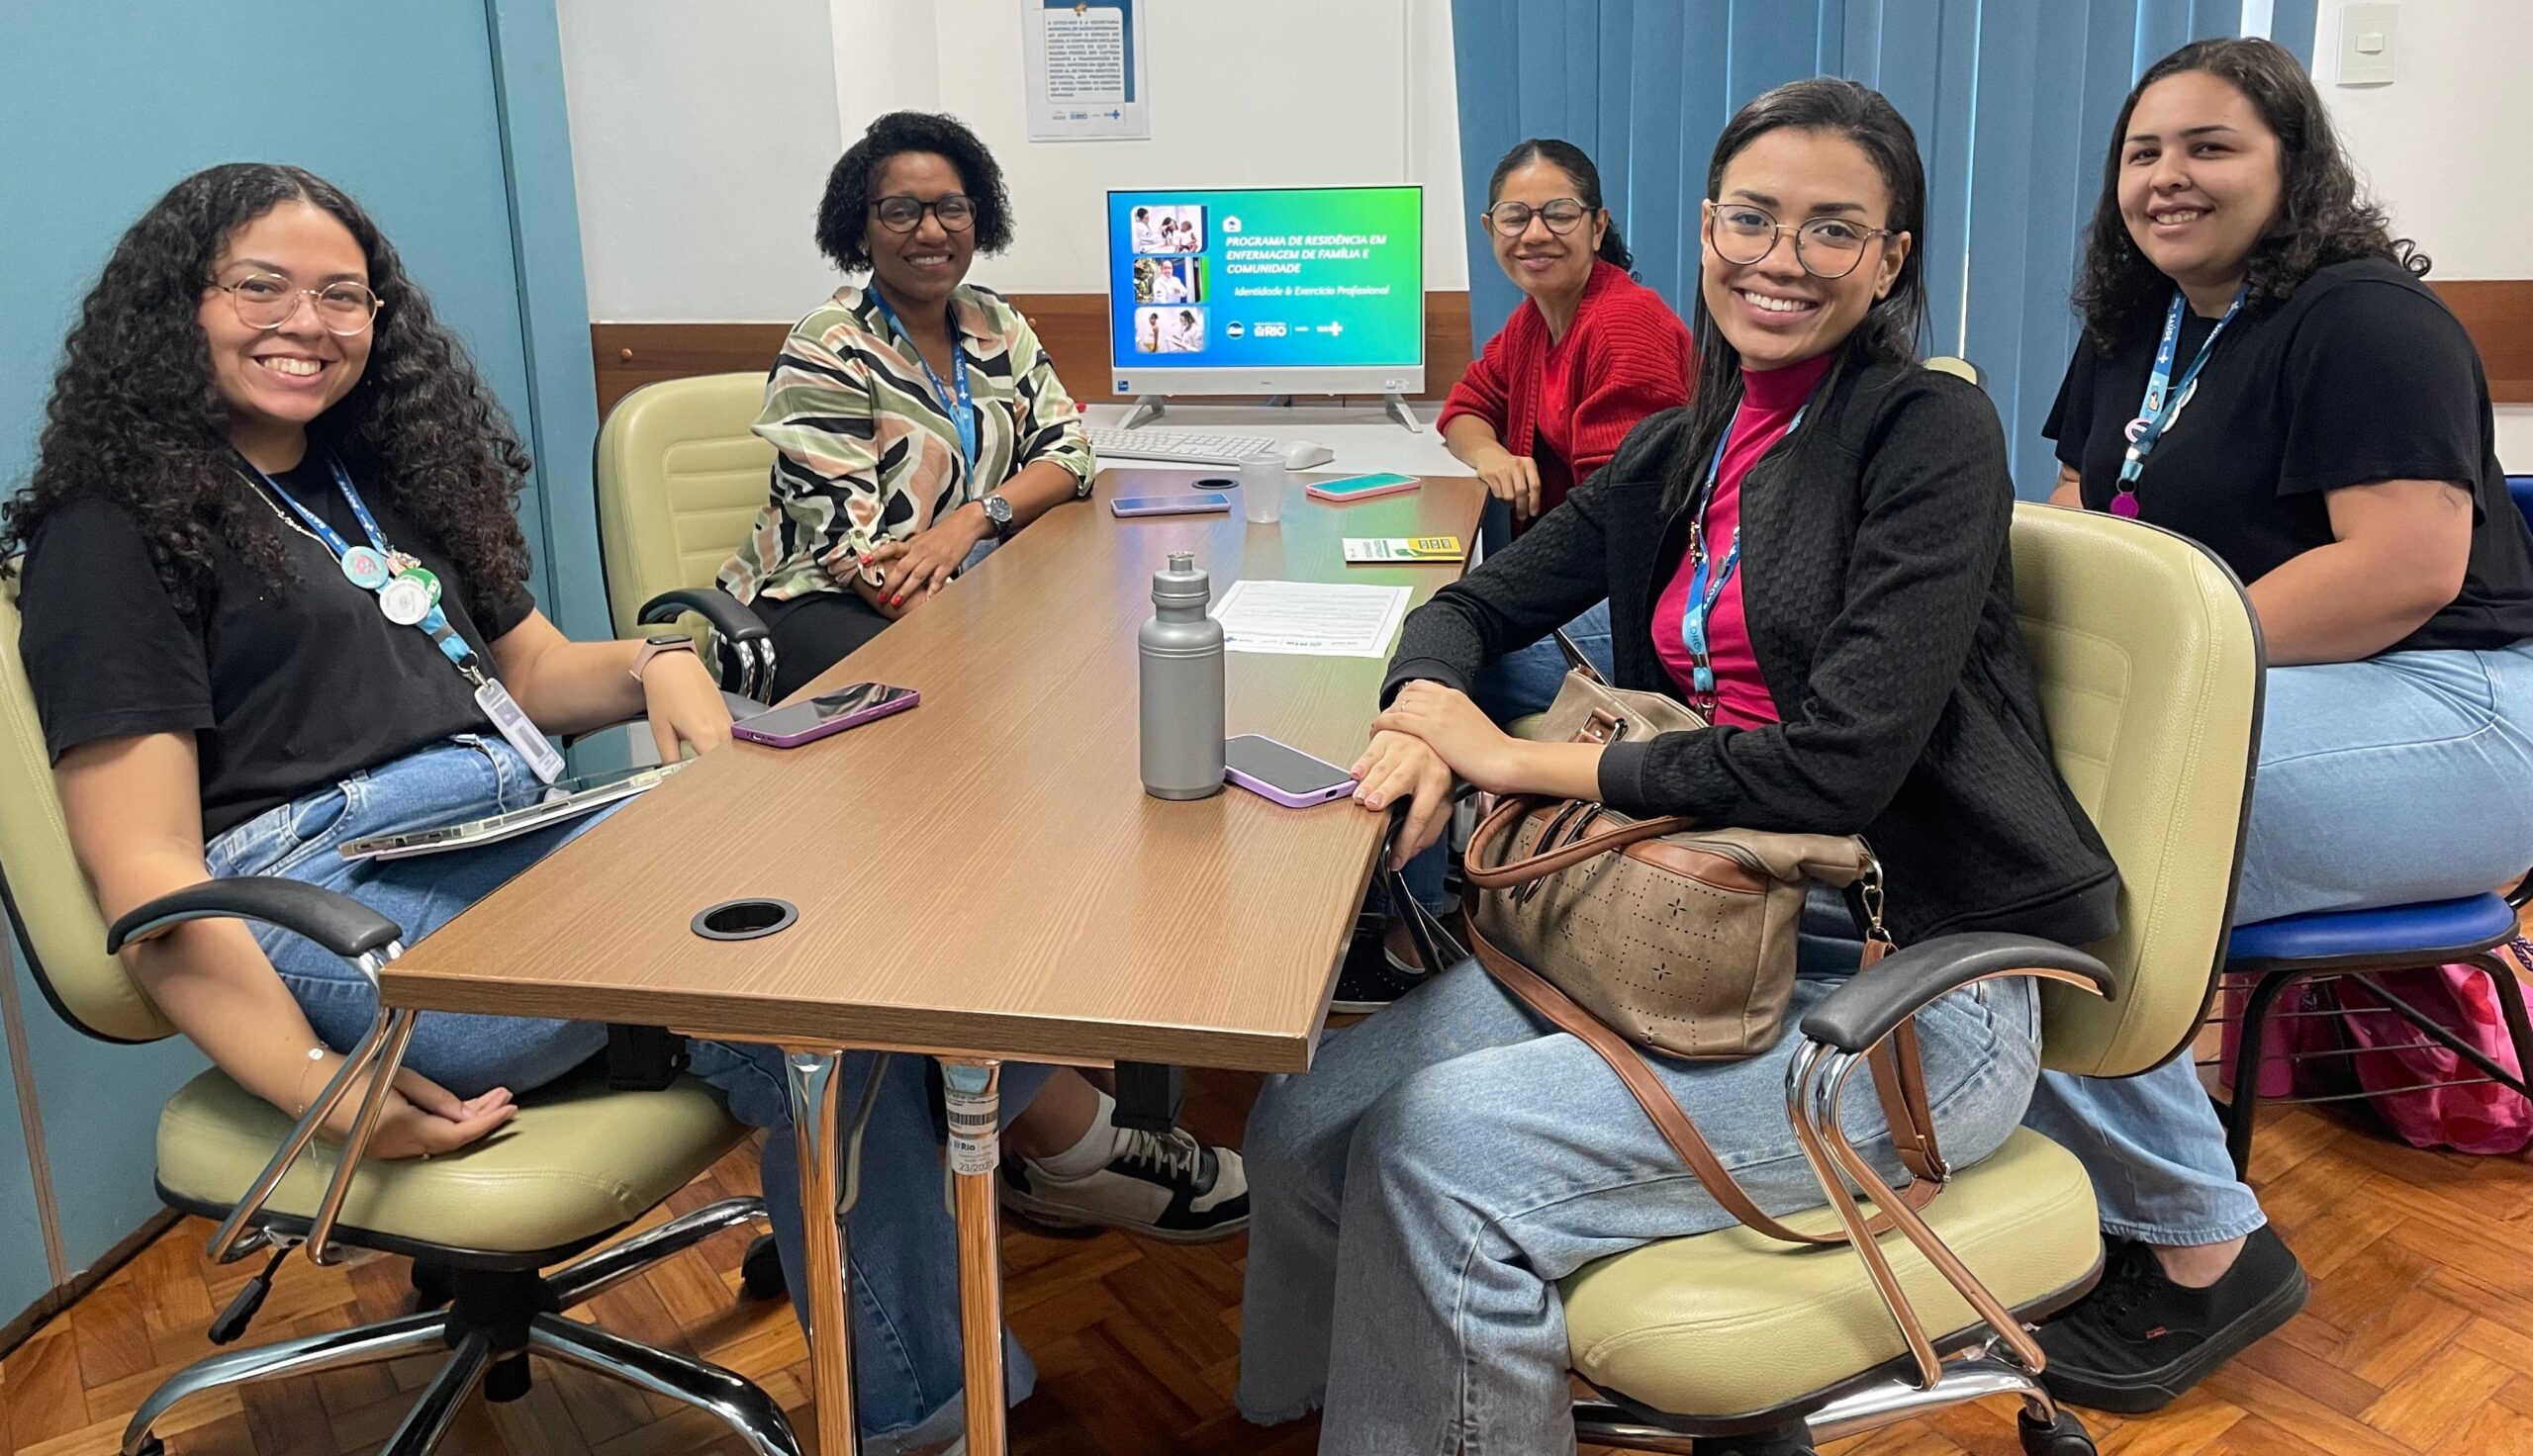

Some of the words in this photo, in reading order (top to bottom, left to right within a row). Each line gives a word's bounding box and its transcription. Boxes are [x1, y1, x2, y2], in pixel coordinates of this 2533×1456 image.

[1226, 236, 1285, 246] PROGRAMA
[1288, 236, 1302, 246] DE
[1305, 233, 1367, 245] RESIDÊNCIA
[1369, 235, 1387, 245] EM
[1226, 250, 1299, 260] ENFERMAGEM
[1301, 249, 1316, 259] DE
[1318, 247, 1360, 259] FAMÍLIA
[1362, 249, 1369, 258] E
[1227, 263, 1301, 274] COMUNIDADE
[1235, 287, 1283, 297] Identidade
[1285, 287, 1293, 296] &
[1338, 285, 1389, 297] Profissional
[1266, 325, 1287, 336] RIO
